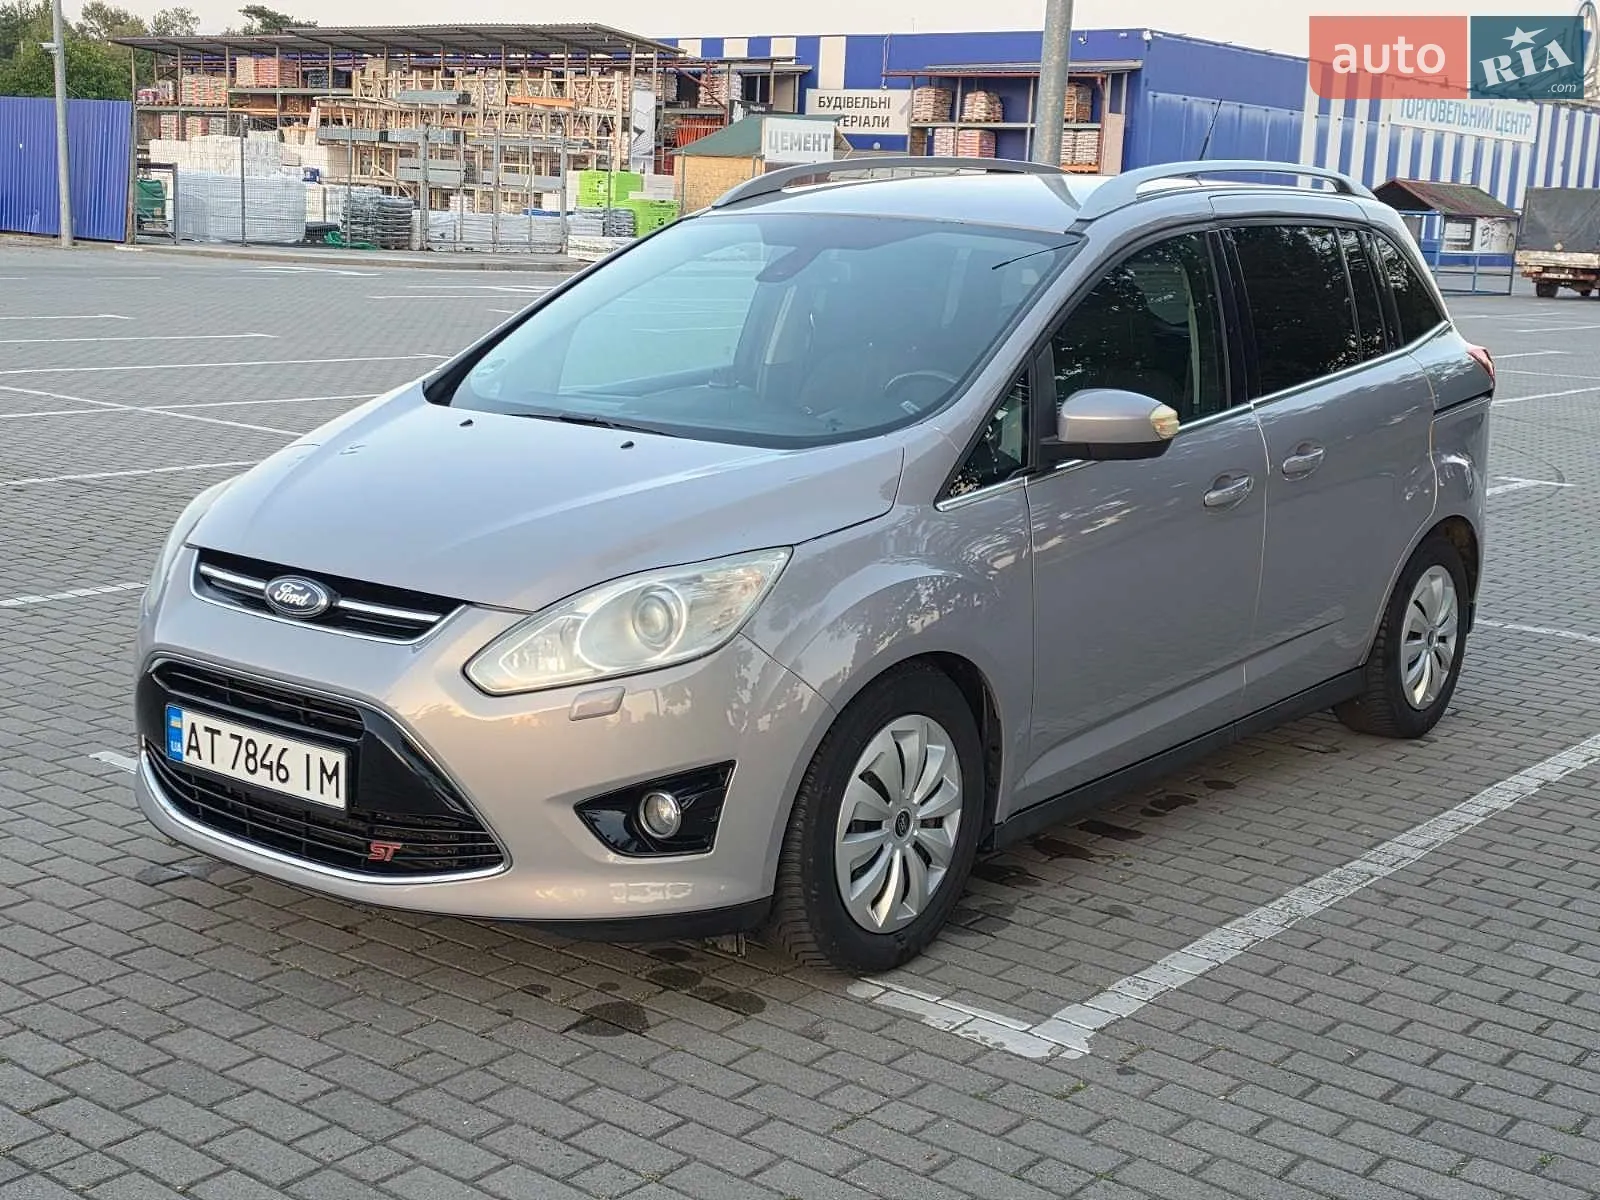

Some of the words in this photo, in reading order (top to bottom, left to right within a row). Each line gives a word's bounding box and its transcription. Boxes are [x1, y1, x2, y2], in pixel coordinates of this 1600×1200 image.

[818, 95, 891, 110] БУДІВЕЛЬНІ
[836, 115, 890, 129] ТЕРІАЛИ
[1400, 97, 1495, 130] ТОРГОВЕЛЬНИЙ
[1495, 108, 1532, 136] ЦЕНТР
[769, 130, 832, 153] ЦЕМЕНТ
[274, 582, 312, 606] Ford
[186, 722, 221, 765] AT
[229, 733, 290, 784] 7846
[305, 753, 340, 799] IM
[368, 840, 402, 862] ST
